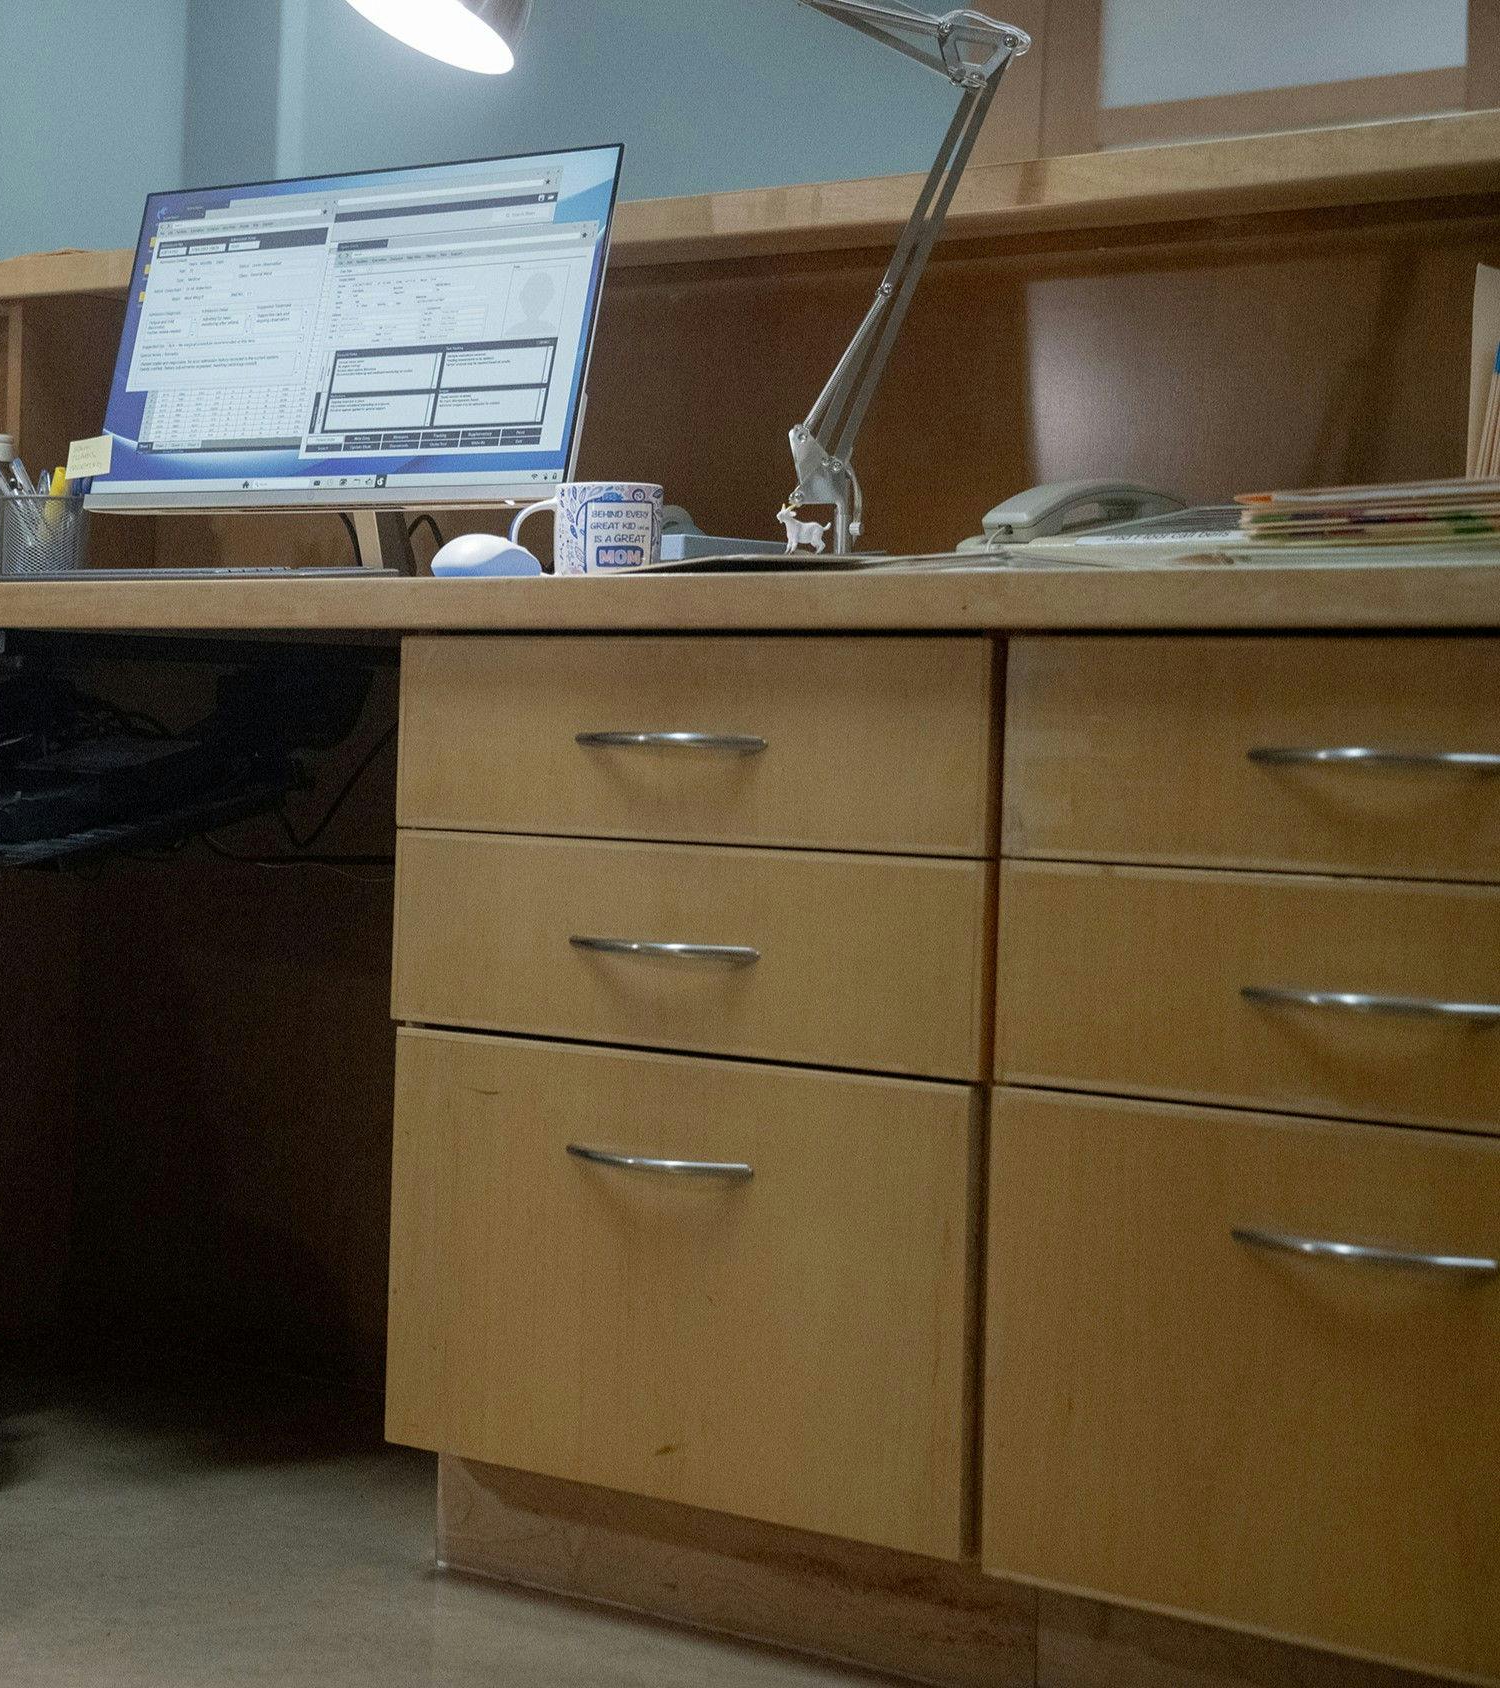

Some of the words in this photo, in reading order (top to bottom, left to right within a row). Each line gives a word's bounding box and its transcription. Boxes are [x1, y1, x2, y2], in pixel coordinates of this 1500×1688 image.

[591, 510, 623, 518] BEHIND
[625, 510, 649, 518] EVERY
[590, 522, 619, 530] GREAT
[622, 522, 636, 530] KID
[594, 535, 602, 543] IS
[604, 535, 611, 543] A
[614, 534, 646, 543] GREAT
[598, 549, 642, 565] MOM
